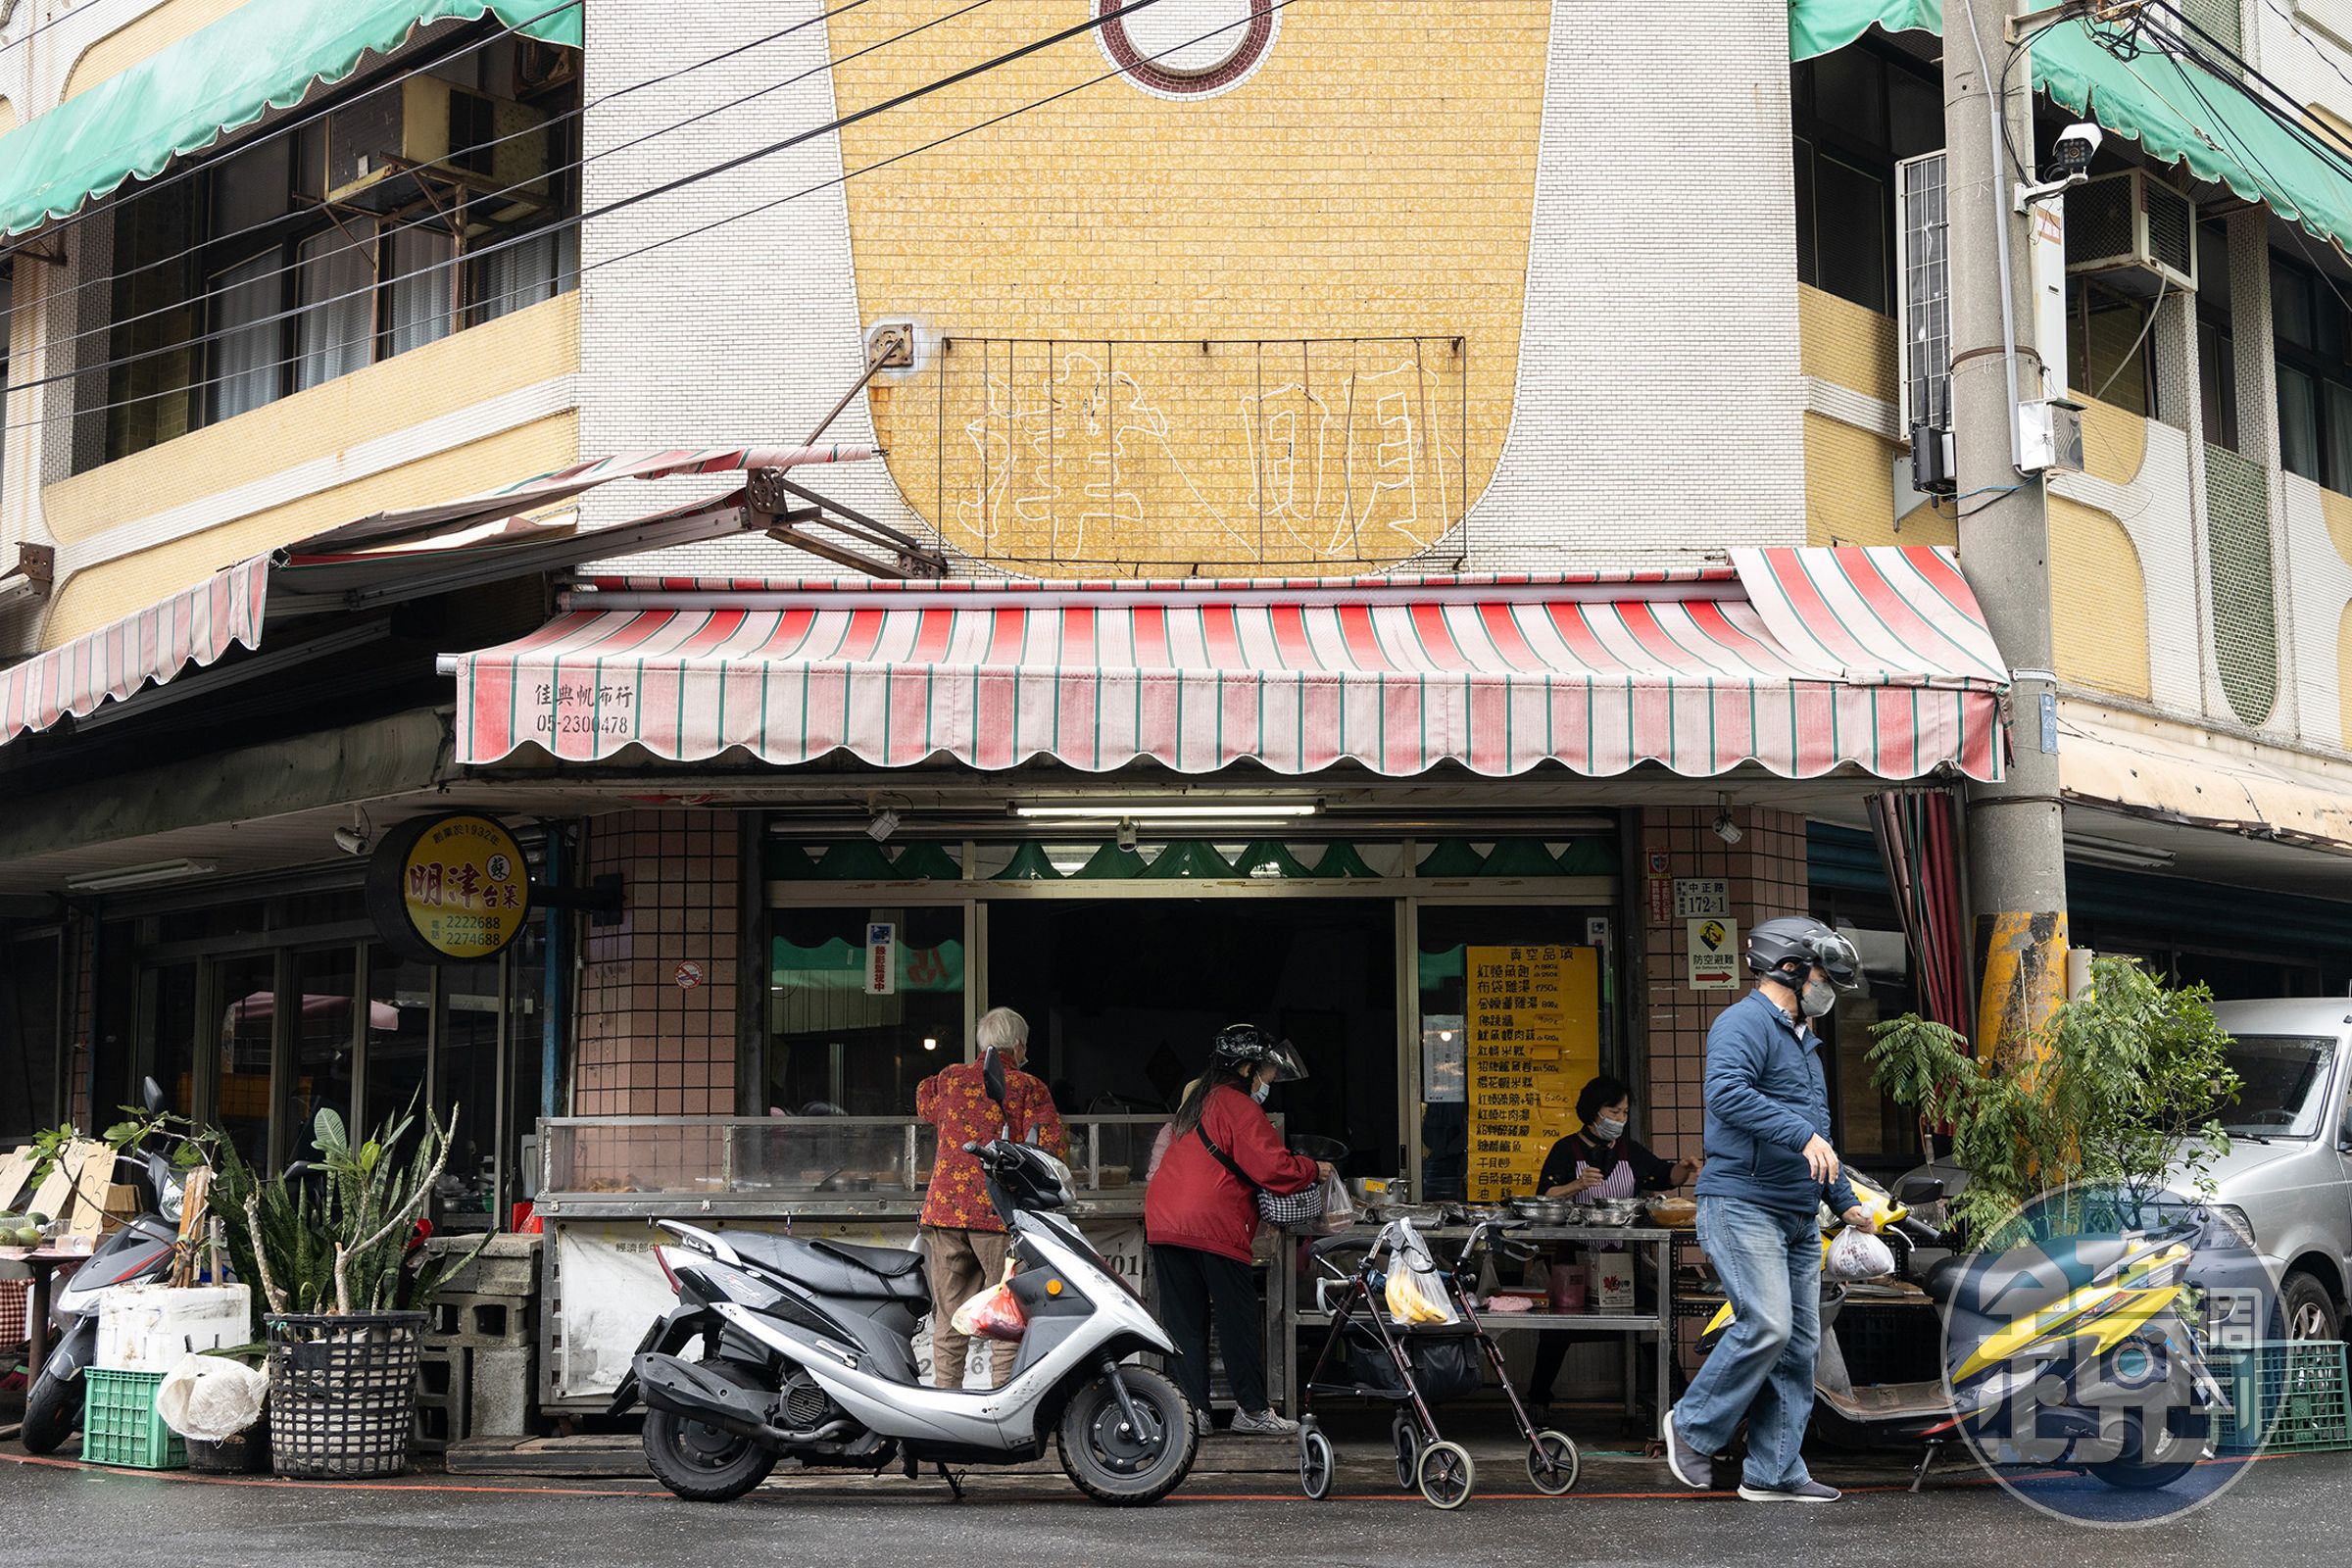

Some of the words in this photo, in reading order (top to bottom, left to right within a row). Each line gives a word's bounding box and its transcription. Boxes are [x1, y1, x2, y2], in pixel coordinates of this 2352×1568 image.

[535, 684, 633, 708] 佳典帆布行
[537, 714, 628, 734] 05-2300478
[409, 862, 481, 907] 明津
[1689, 882, 1724, 894] 中正路
[482, 884, 520, 909] 台菜
[446, 915, 501, 929] 2222688
[446, 932, 501, 945] 2274688
[1693, 954, 1734, 965] 防空避難
